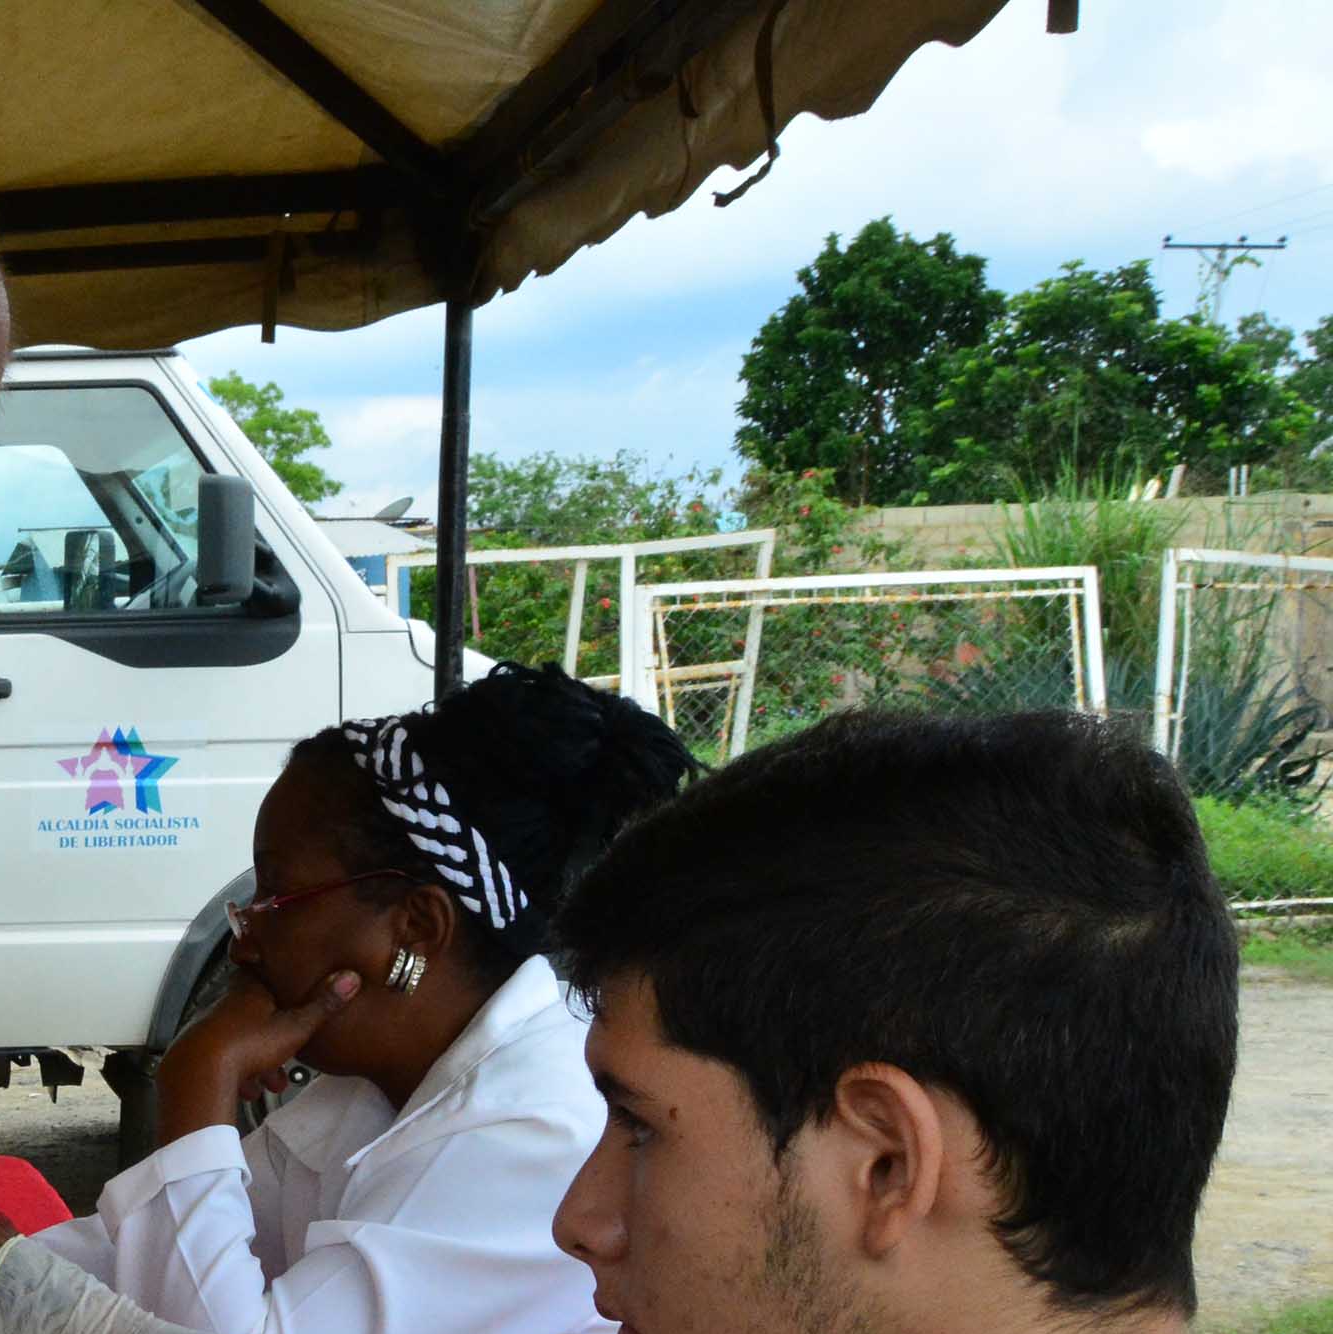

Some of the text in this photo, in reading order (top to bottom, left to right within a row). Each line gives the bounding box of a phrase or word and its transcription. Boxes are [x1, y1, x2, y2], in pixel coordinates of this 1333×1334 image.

[114, 816, 200, 830] SOCIALISTA
[59, 834, 179, 849] DE LIBERTADOR
